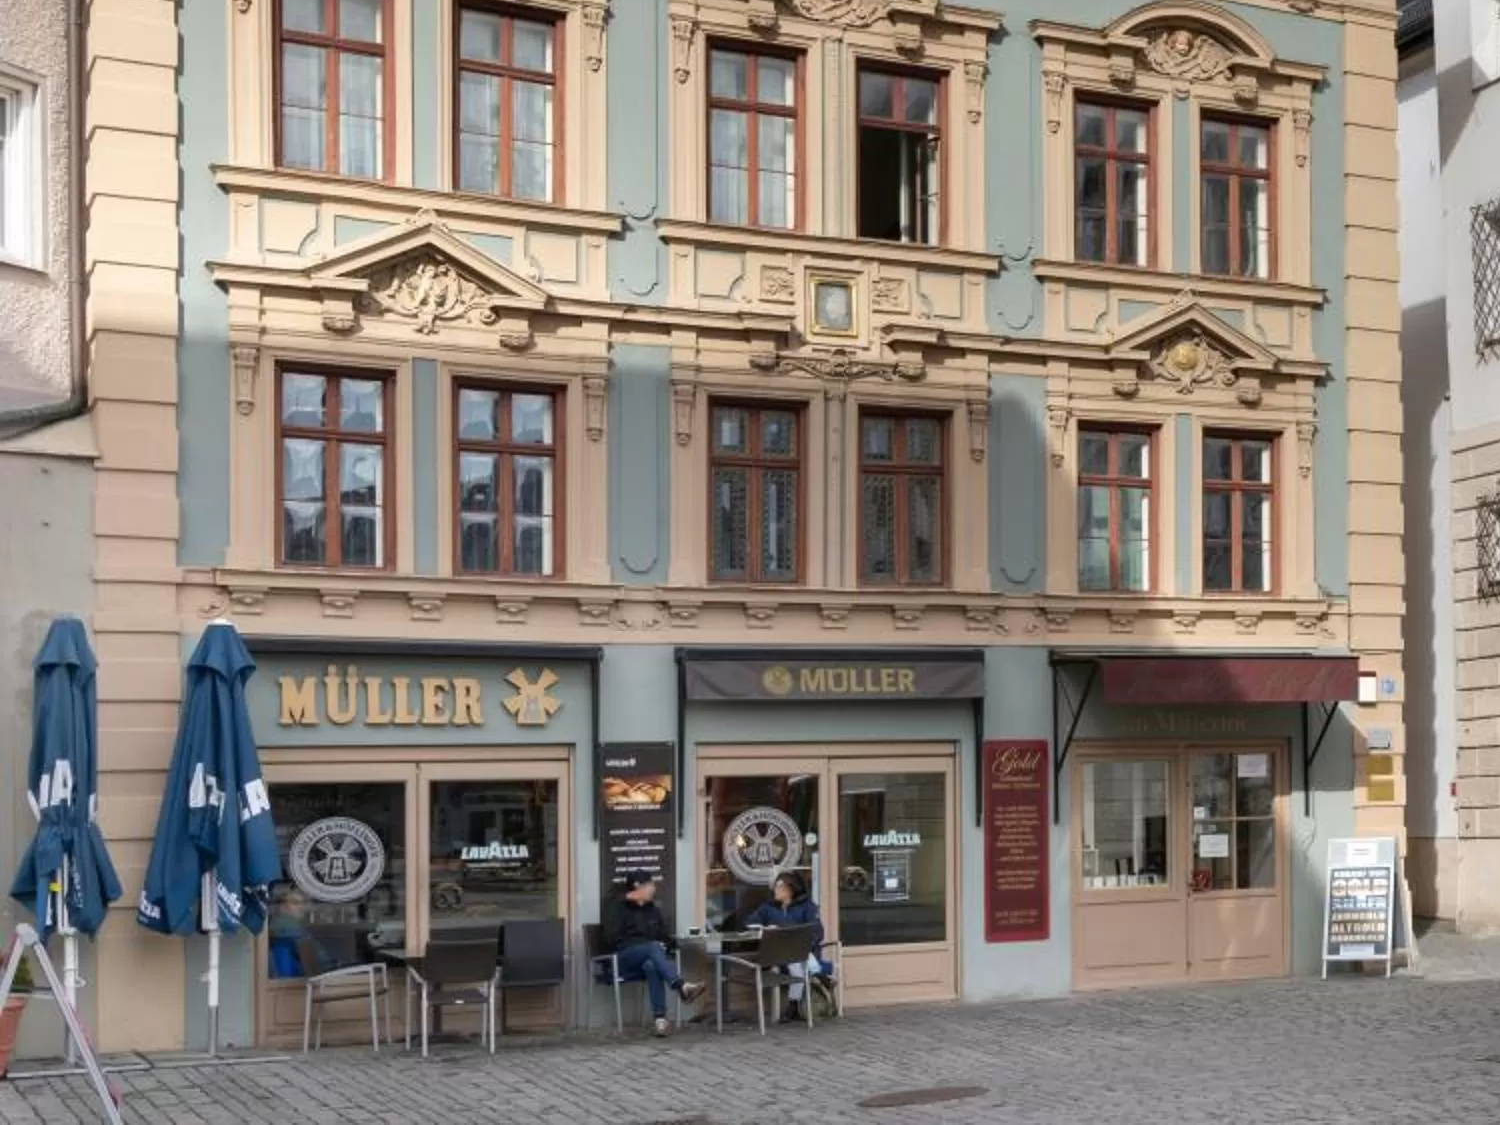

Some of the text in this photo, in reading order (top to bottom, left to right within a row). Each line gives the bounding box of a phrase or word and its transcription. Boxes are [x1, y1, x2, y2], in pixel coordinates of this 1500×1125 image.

[279, 665, 485, 725] MÜLLER
[992, 747, 1041, 776] Gold
[863, 829, 920, 846] LAVAZZA
[461, 840, 529, 860] LAVAZZA
[1332, 878, 1388, 896] GOLD
